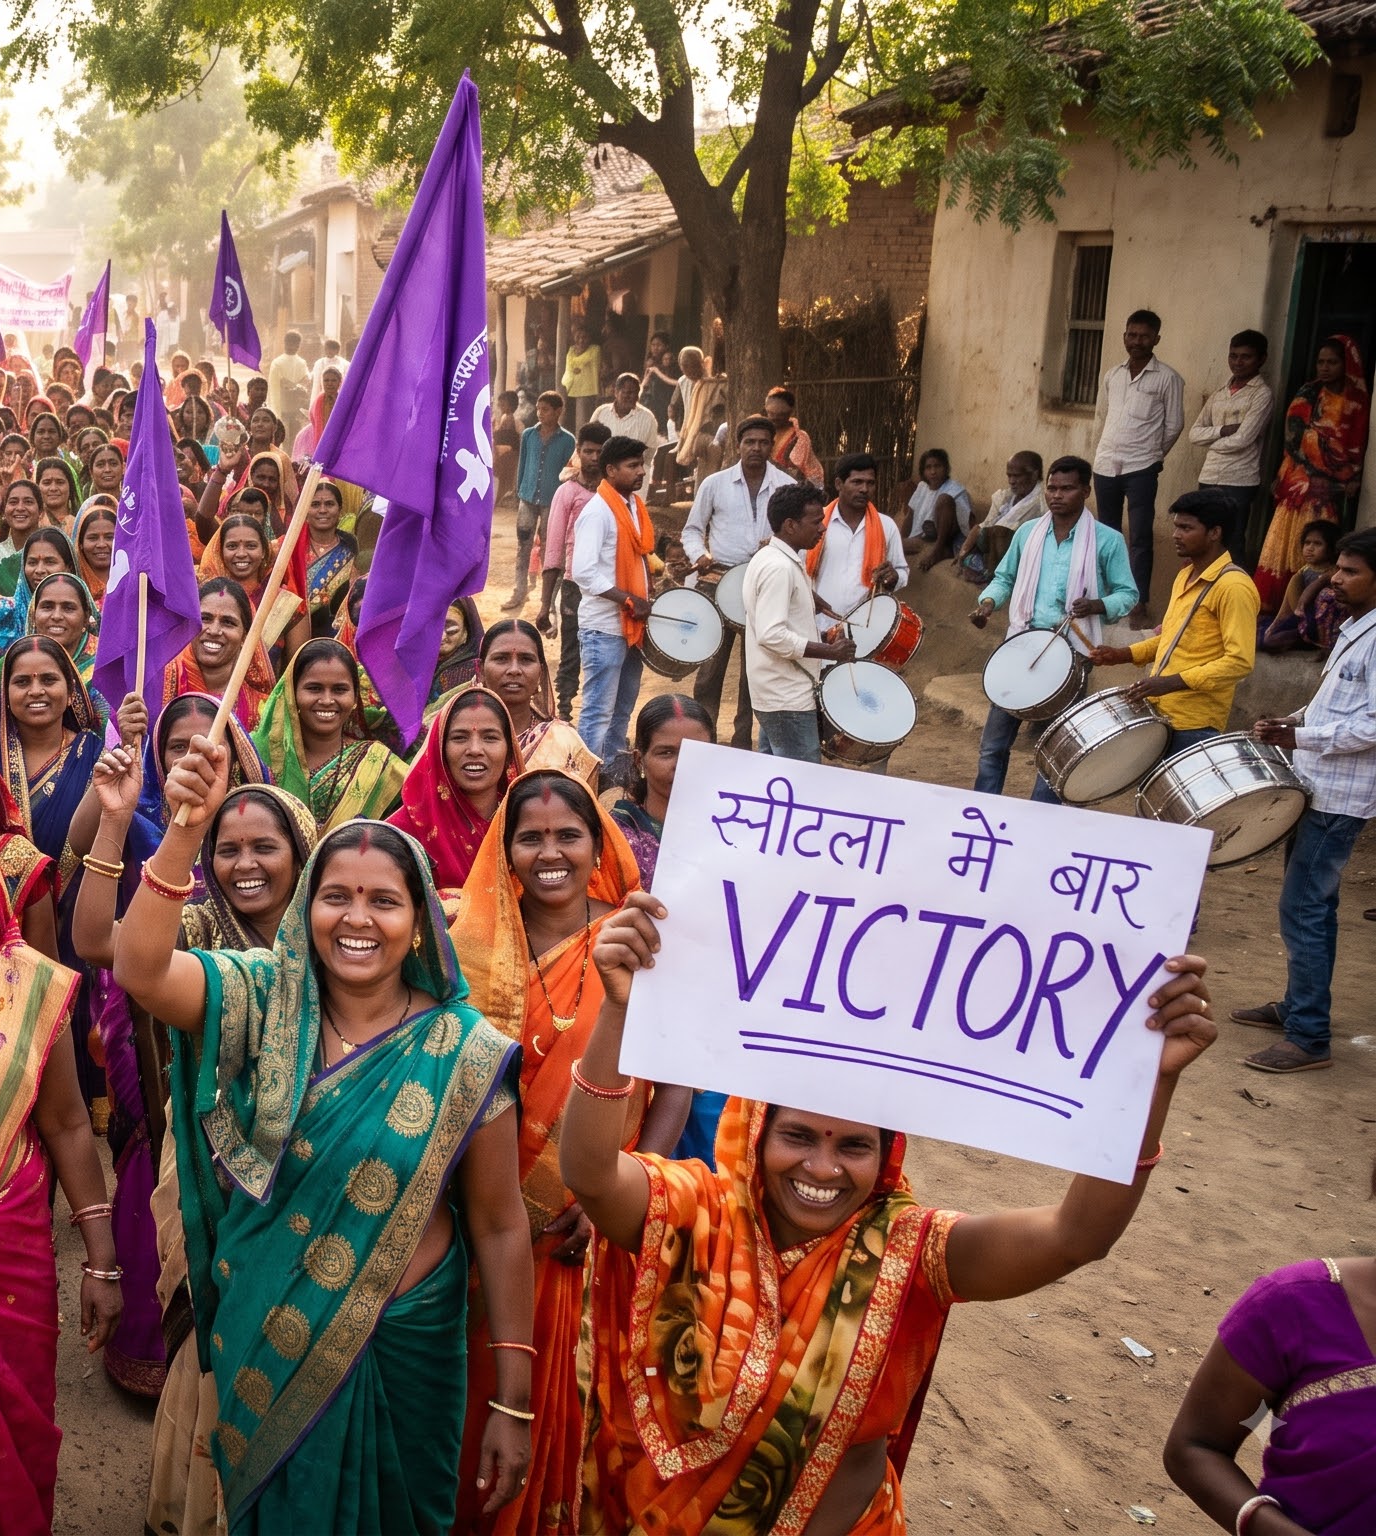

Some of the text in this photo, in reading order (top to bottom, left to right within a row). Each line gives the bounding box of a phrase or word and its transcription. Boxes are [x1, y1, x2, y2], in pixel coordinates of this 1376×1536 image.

[948, 807, 1013, 892] में
[1050, 851, 1152, 929] बार
[722, 879, 1167, 1079] VICTORY
